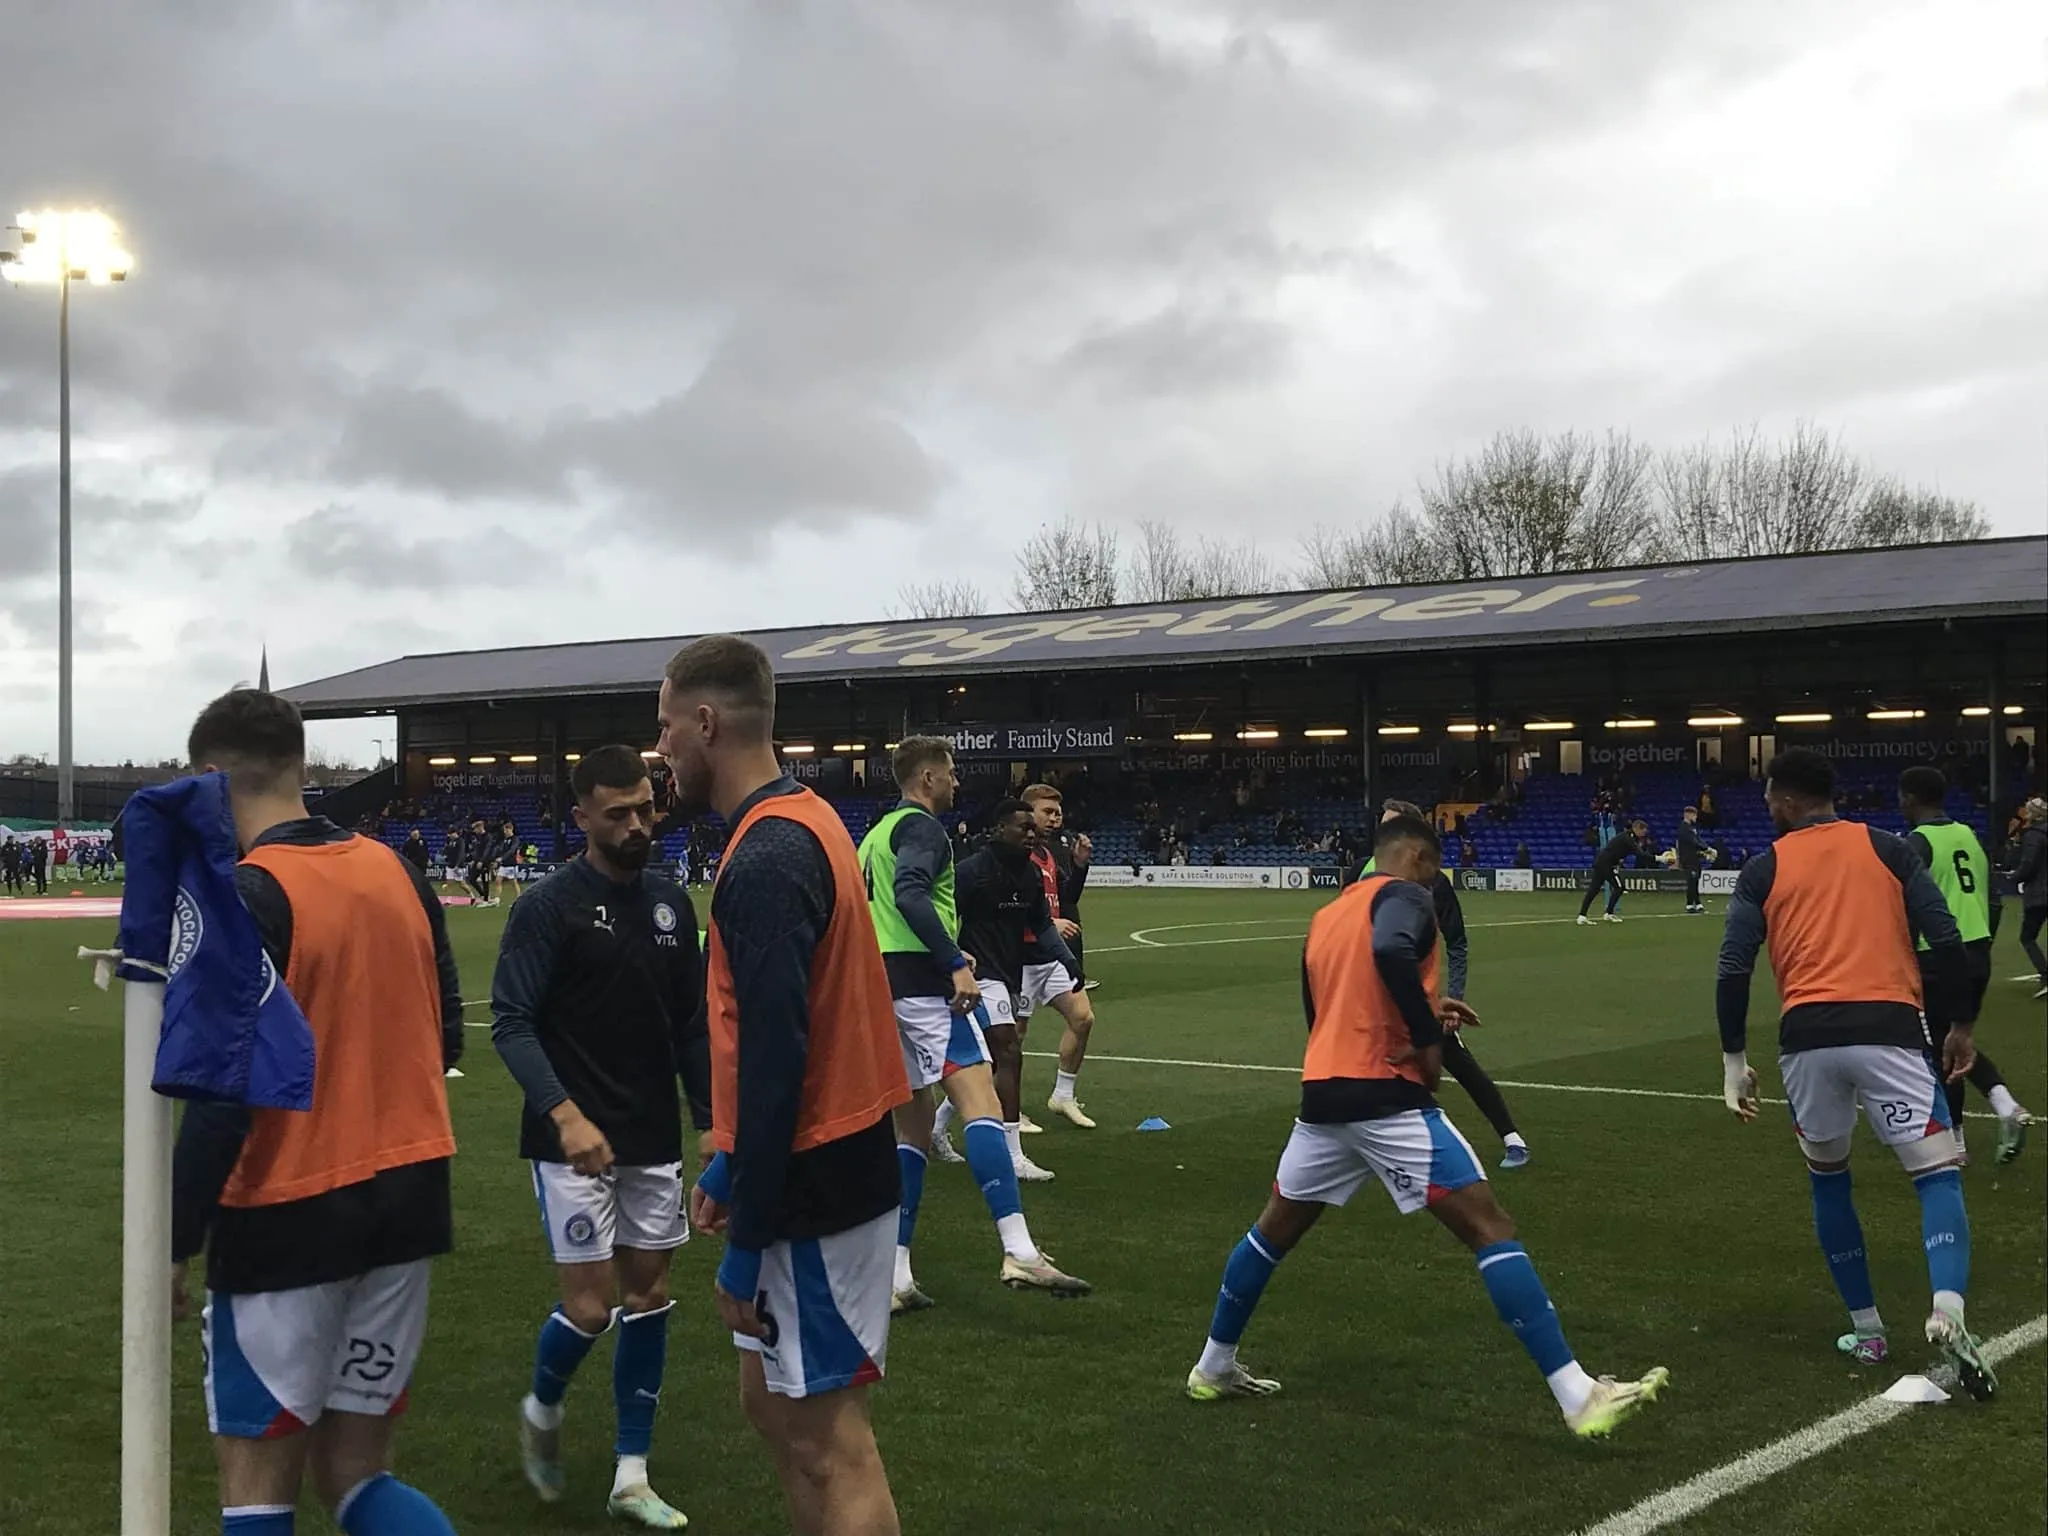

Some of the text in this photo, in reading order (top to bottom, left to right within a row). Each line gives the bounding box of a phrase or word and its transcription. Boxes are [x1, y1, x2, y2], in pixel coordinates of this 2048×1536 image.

[781, 577, 1646, 666] together.
[1007, 729, 1062, 752] Family
[1066, 727, 1113, 748] Stand
[1289, 750, 1313, 769] for
[1315, 749, 1340, 769] the
[1381, 746, 1440, 769] normal
[46, 836, 108, 850] CKPRT
[1953, 849, 1975, 894] 6
[1312, 874, 1338, 886] VITA
[1536, 873, 1577, 889] Luna
[1624, 877, 1658, 891] una
[654, 934, 678, 947] VITA
